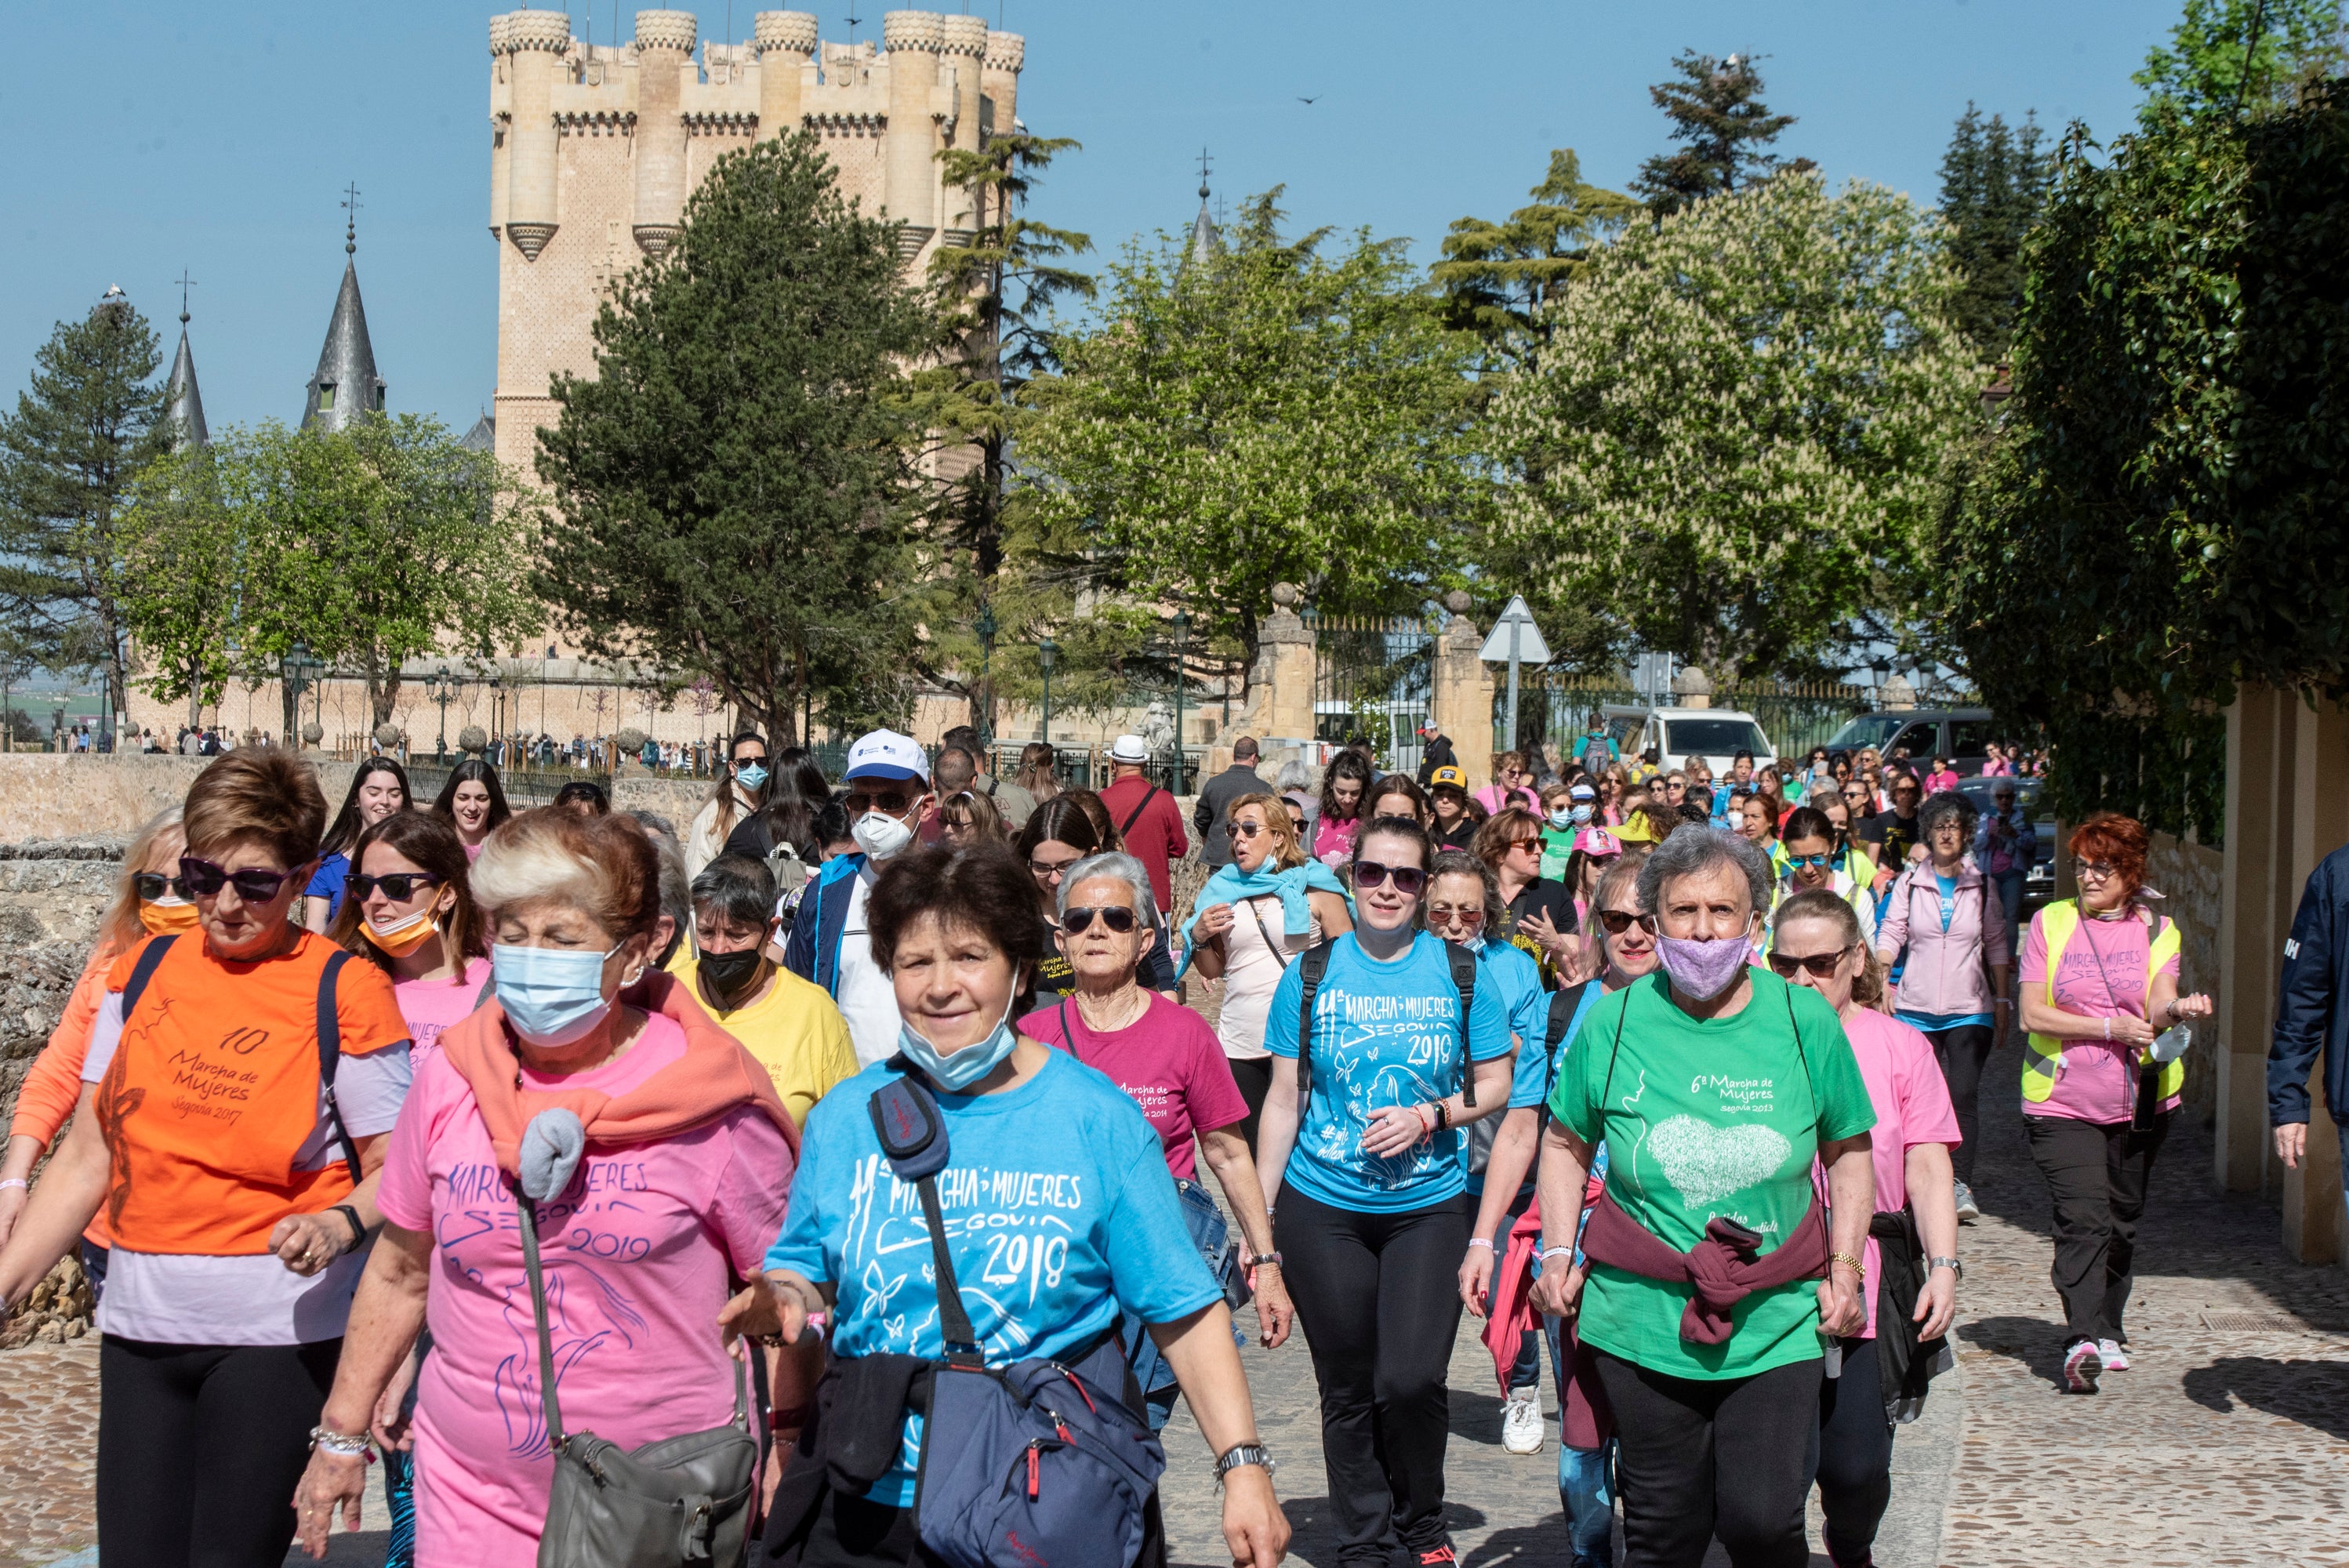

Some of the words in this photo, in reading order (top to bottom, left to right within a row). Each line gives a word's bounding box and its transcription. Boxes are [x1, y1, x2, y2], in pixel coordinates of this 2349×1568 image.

[1041, 956, 1062, 966] archa
[2106, 950, 2141, 967] MUJERES
[2109, 978, 2144, 993] 2019
[1345, 994, 1398, 1024] MARCHA
[1406, 996, 1454, 1021] MUJERES
[220, 1026, 270, 1054] 10
[408, 1022, 448, 1041] MUJER
[1340, 1022, 1452, 1048] SEGOVIA
[168, 1049, 238, 1080] Marcha
[239, 1071, 259, 1083] de
[1407, 1033, 1452, 1077] 2018
[172, 1069, 249, 1100] Mujeres
[1691, 1074, 1707, 1093] 6ª
[1710, 1074, 1758, 1090] Marcha
[1761, 1077, 1773, 1087] de
[1719, 1088, 1774, 1104] Mujeres
[172, 1094, 212, 1120] Segovia
[212, 1106, 243, 1127] 2017
[1136, 1096, 1167, 1109] ujeres
[447, 1162, 510, 1209] MARC
[568, 1162, 648, 1200] UJERES
[888, 1168, 978, 1215] MACHA
[991, 1170, 1082, 1210] MUJERES
[566, 1228, 651, 1265] 2019
[982, 1232, 1069, 1310] 2018
